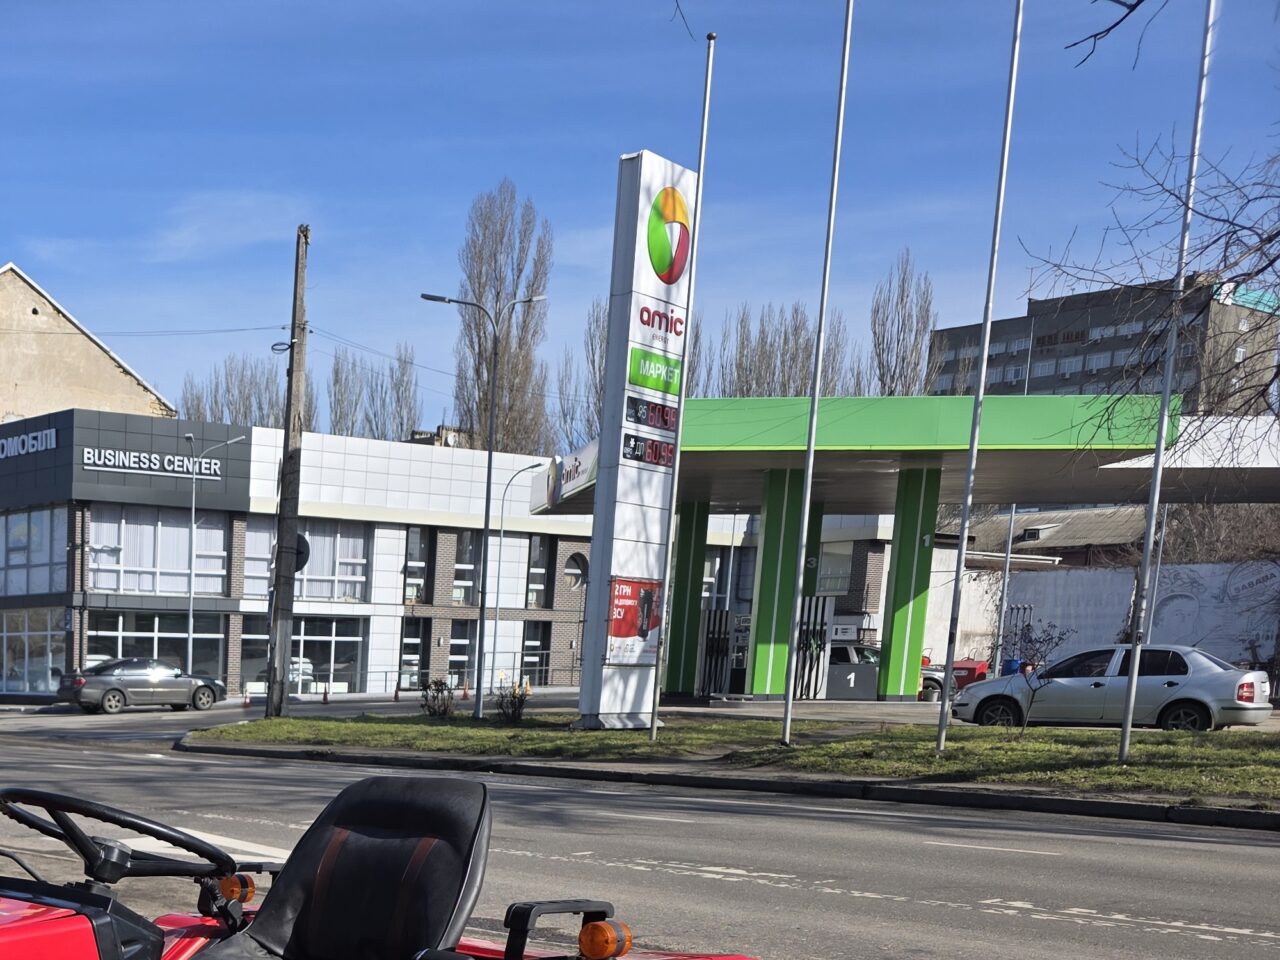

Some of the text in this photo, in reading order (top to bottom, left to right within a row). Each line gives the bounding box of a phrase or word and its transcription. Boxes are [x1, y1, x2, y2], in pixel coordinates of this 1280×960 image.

[640, 306, 684, 336] amic
[640, 360, 680, 384] МАРКЕТ
[83, 447, 221, 475] BUSINESS CENTER
[806, 557, 817, 568] 3
[846, 672, 856, 688] 1
